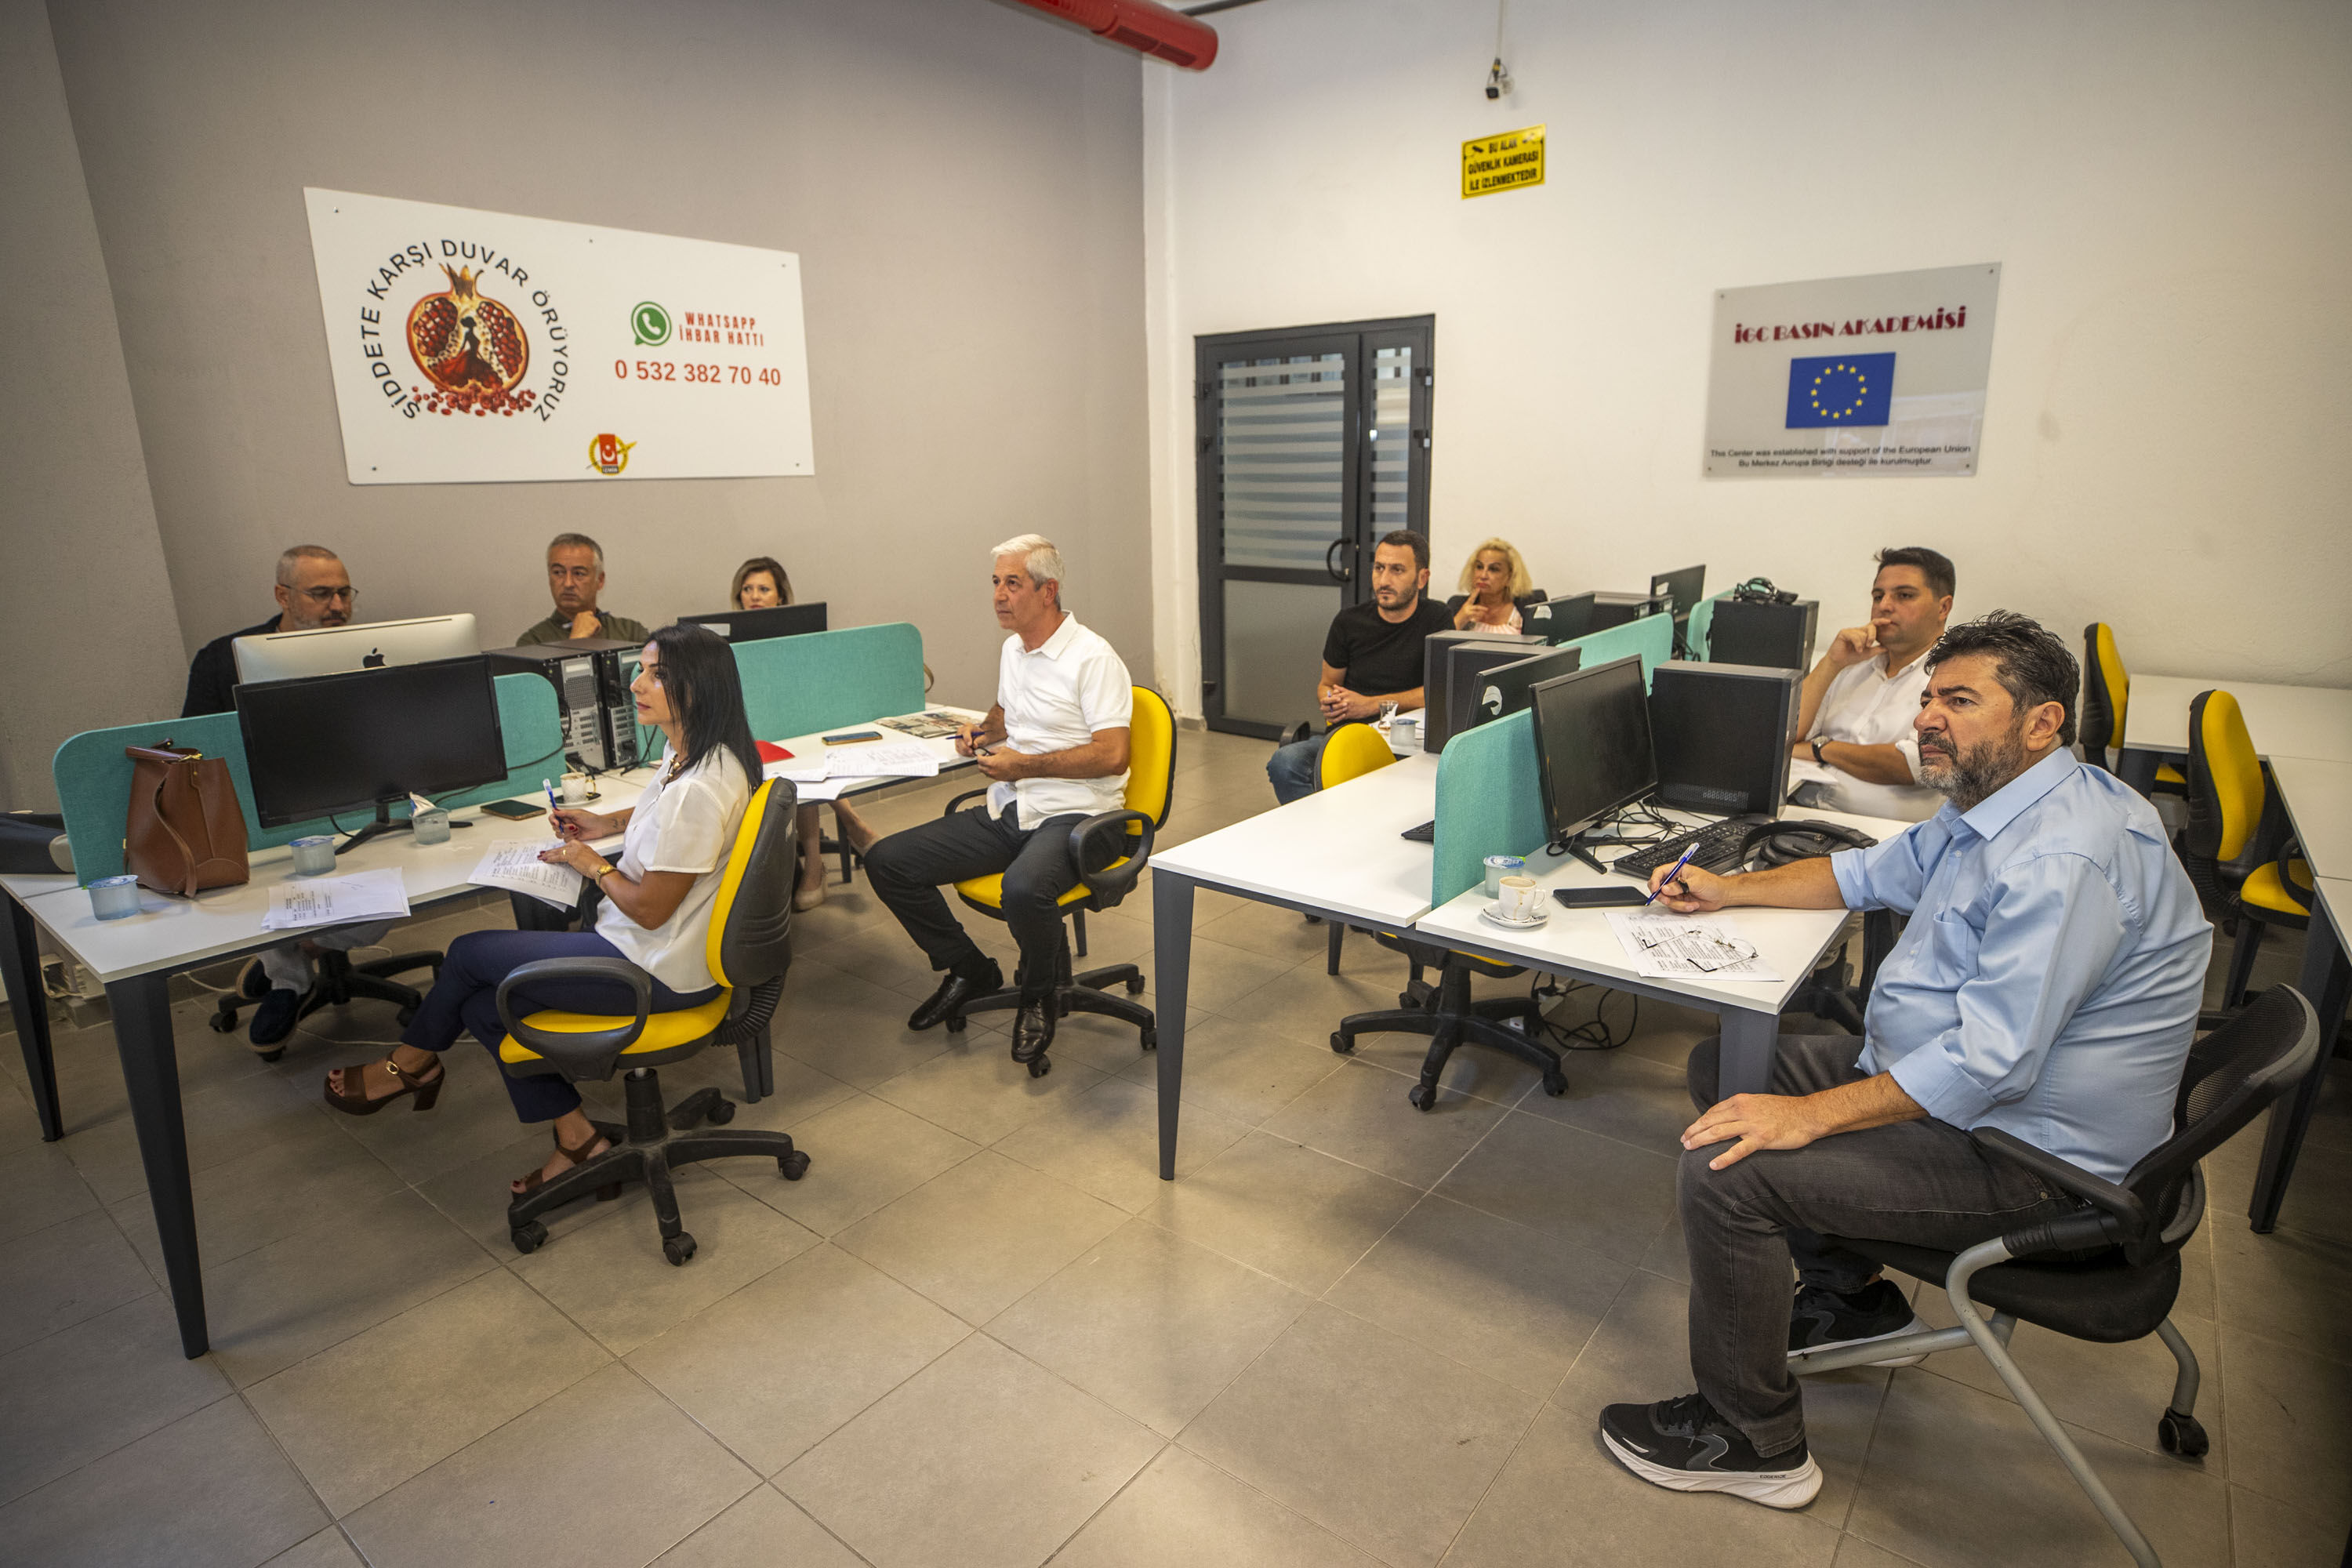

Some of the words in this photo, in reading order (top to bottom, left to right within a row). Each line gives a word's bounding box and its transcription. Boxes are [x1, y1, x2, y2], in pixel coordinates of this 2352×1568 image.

[1503, 150, 1539, 167] KAMERASI
[684, 311, 756, 330] WHATSAPP
[367, 241, 433, 300] KARŞI
[441, 239, 528, 287] DUVAR
[532, 289, 569, 422] ÖRÜYORUZ
[679, 324, 720, 343] İHBAR
[728, 331, 764, 347] HATTI
[1773, 321, 1835, 341] BASIN
[615, 359, 627, 379] 0
[636, 361, 676, 381] 532
[684, 363, 721, 383] 382
[728, 365, 751, 384] 70
[758, 368, 781, 386] 40
[1711, 448, 1726, 457] This
[1728, 448, 1754, 457] Center
[1773, 447, 1818, 456] established
[1820, 446, 1837, 456] with
[1838, 447, 1870, 456] support
[1871, 445, 1882, 455] of
[1882, 445, 1896, 454] the
[1898, 445, 1941, 456] European
[1944, 444, 1971, 454] Union
[1738, 459, 1750, 467] Bu
[1751, 459, 1780, 467] Merkez
[1780, 458, 1810, 468] Avrupa
